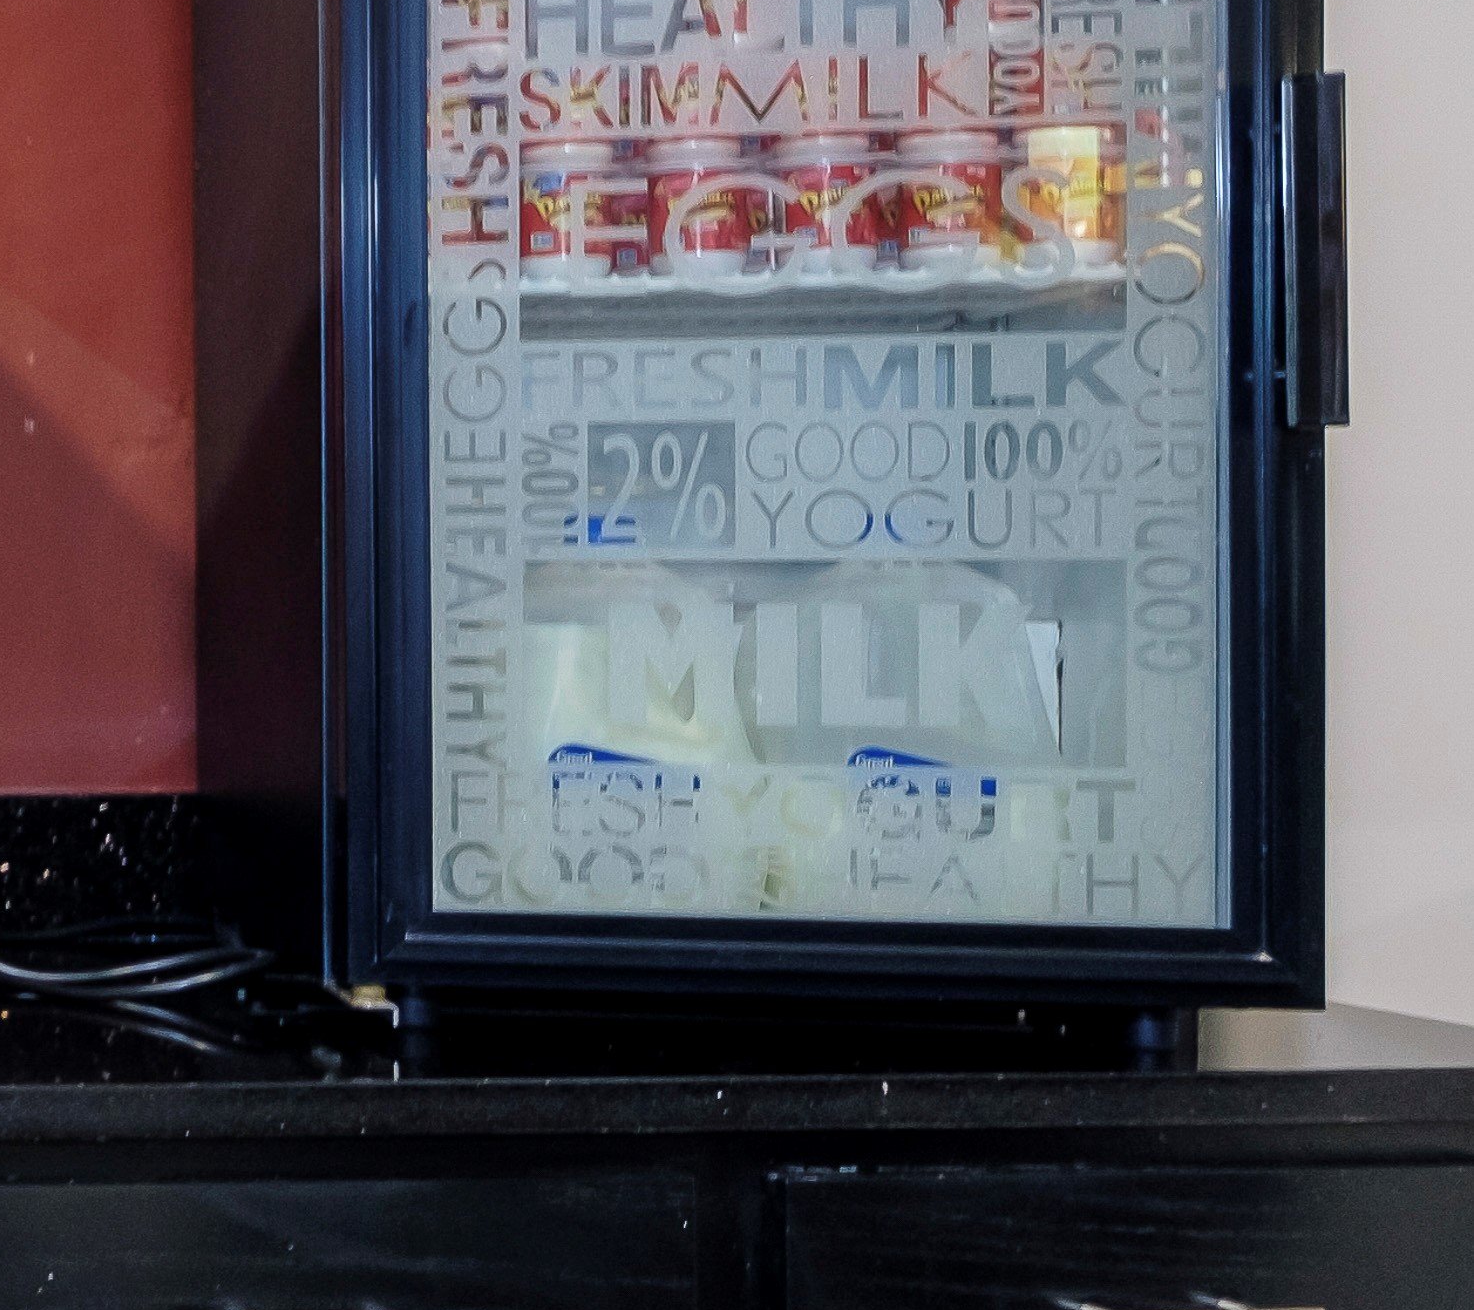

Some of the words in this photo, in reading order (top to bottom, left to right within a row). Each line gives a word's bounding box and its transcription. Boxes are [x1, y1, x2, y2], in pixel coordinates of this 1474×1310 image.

[569, 167, 1076, 289] EGGS
[1132, 193, 1205, 513] YOGURT
[521, 422, 579, 555] 100%
[601, 429, 727, 544] 2%
[745, 421, 950, 483] GOOD
[962, 420, 1123, 482] 100%
[752, 488, 1116, 551] YOGURT
[445, 473, 508, 772] HEALTHY
[1132, 516, 1205, 675] GOOD
[610, 601, 1040, 727] MILK
